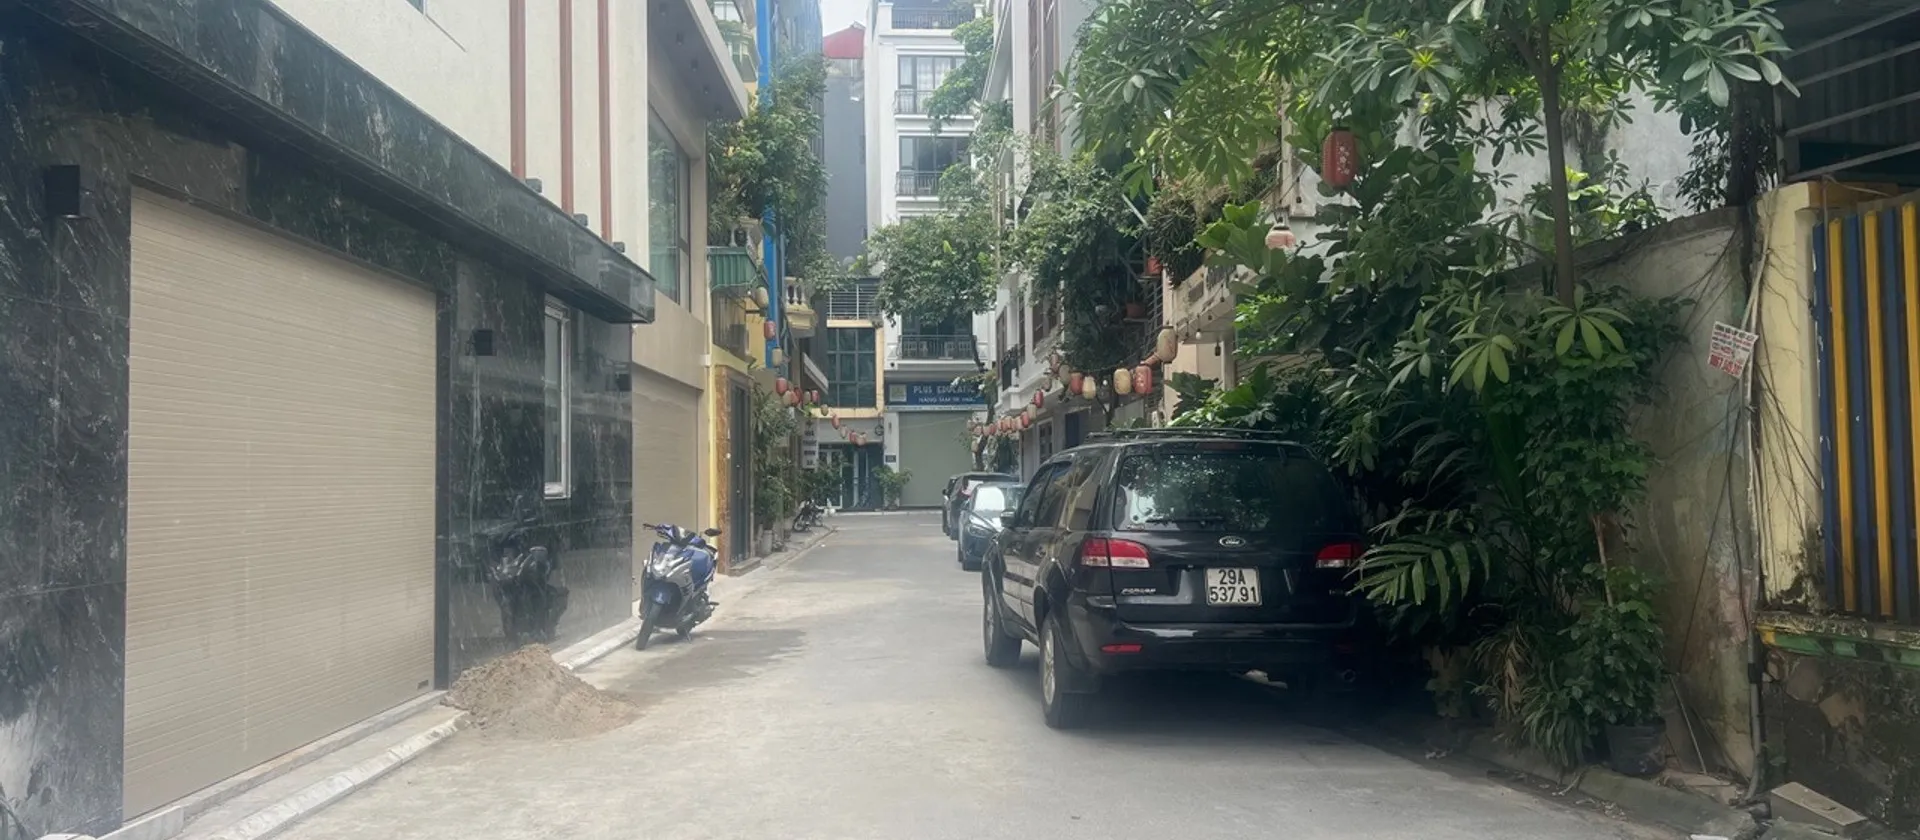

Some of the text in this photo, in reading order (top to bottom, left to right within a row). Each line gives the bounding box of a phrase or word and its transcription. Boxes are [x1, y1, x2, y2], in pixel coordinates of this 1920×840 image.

[913, 385, 933, 394] PLUS
[1218, 569, 1246, 585] 29A
[1209, 586, 1257, 603] 537.91
